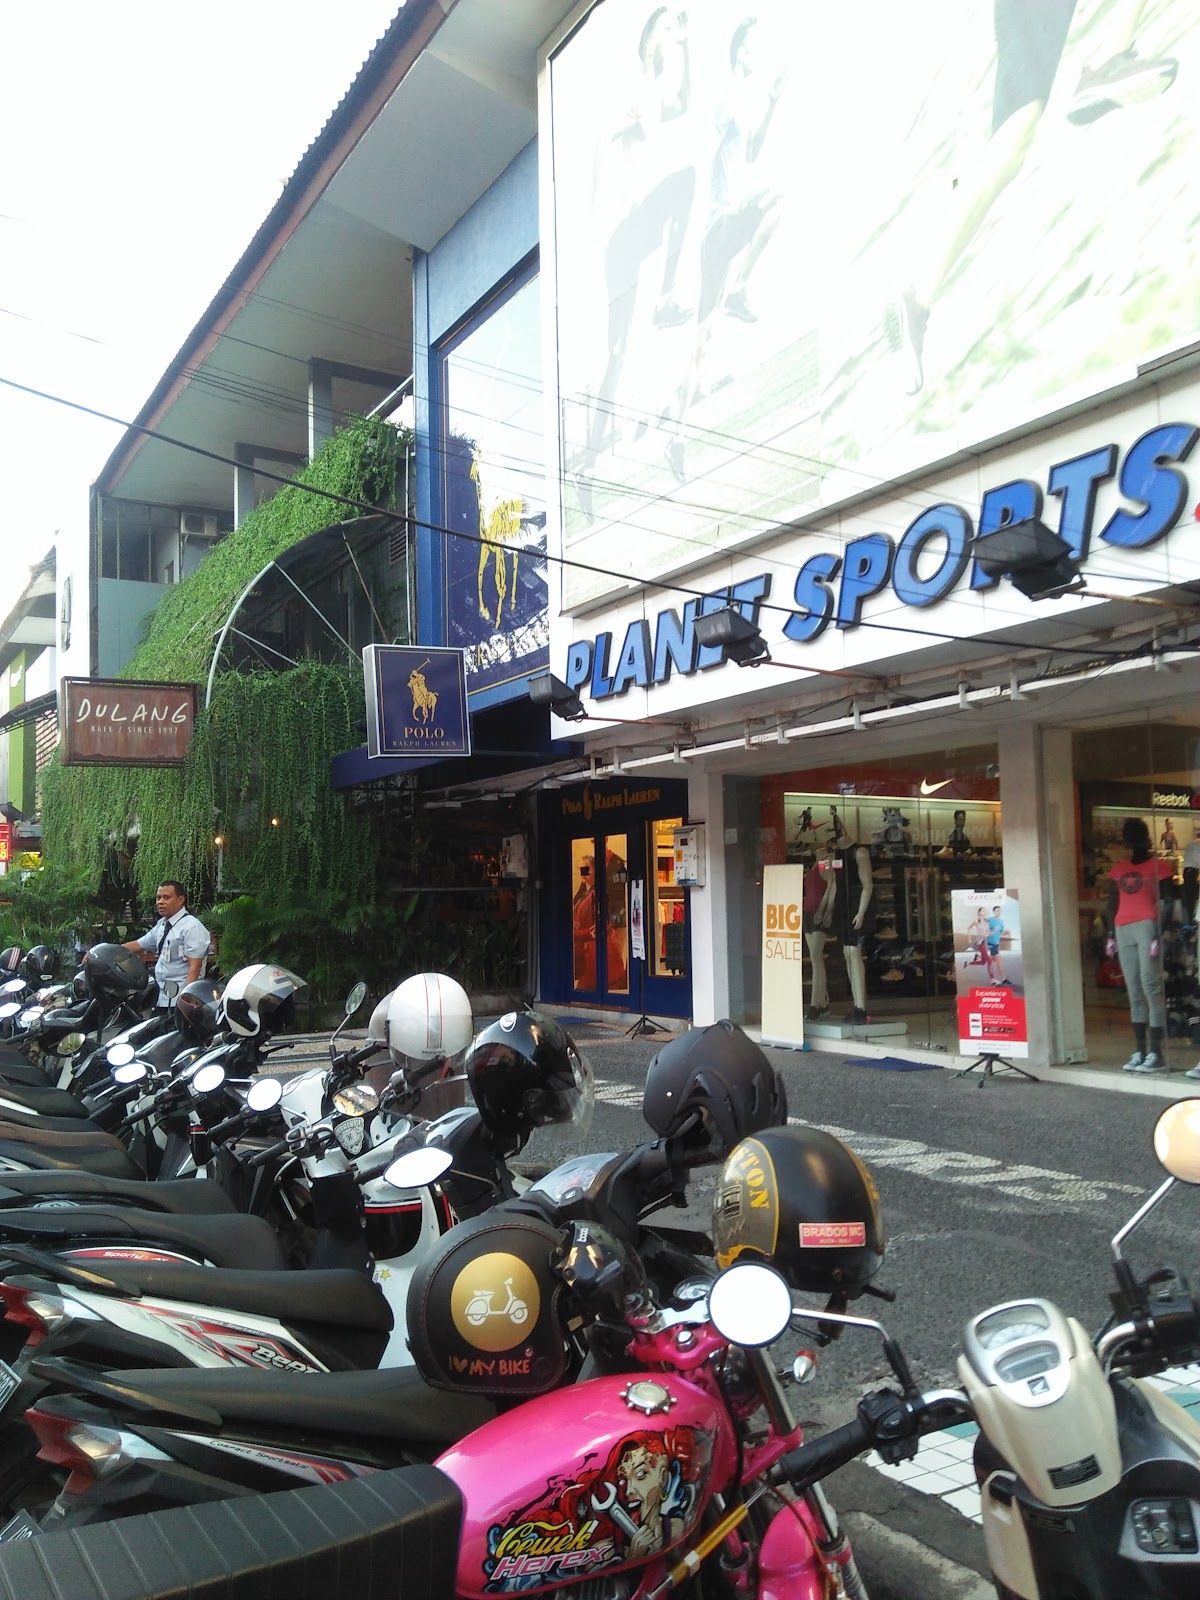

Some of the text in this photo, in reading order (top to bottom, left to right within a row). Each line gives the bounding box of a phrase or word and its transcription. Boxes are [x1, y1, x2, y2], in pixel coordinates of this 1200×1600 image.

[566, 421, 1200, 699] PLANET SPORTS
[76, 698, 188, 724] DULANG
[128, 726, 153, 734] SINCE
[404, 727, 445, 739] POLO
[1152, 792, 1190, 807] Reebok
[766, 904, 801, 931] BIG
[766, 939, 801, 961] SALE
[469, 1360, 496, 1376] MY
[499, 1359, 531, 1375] BIKE
[490, 1543, 615, 1580] Herex
